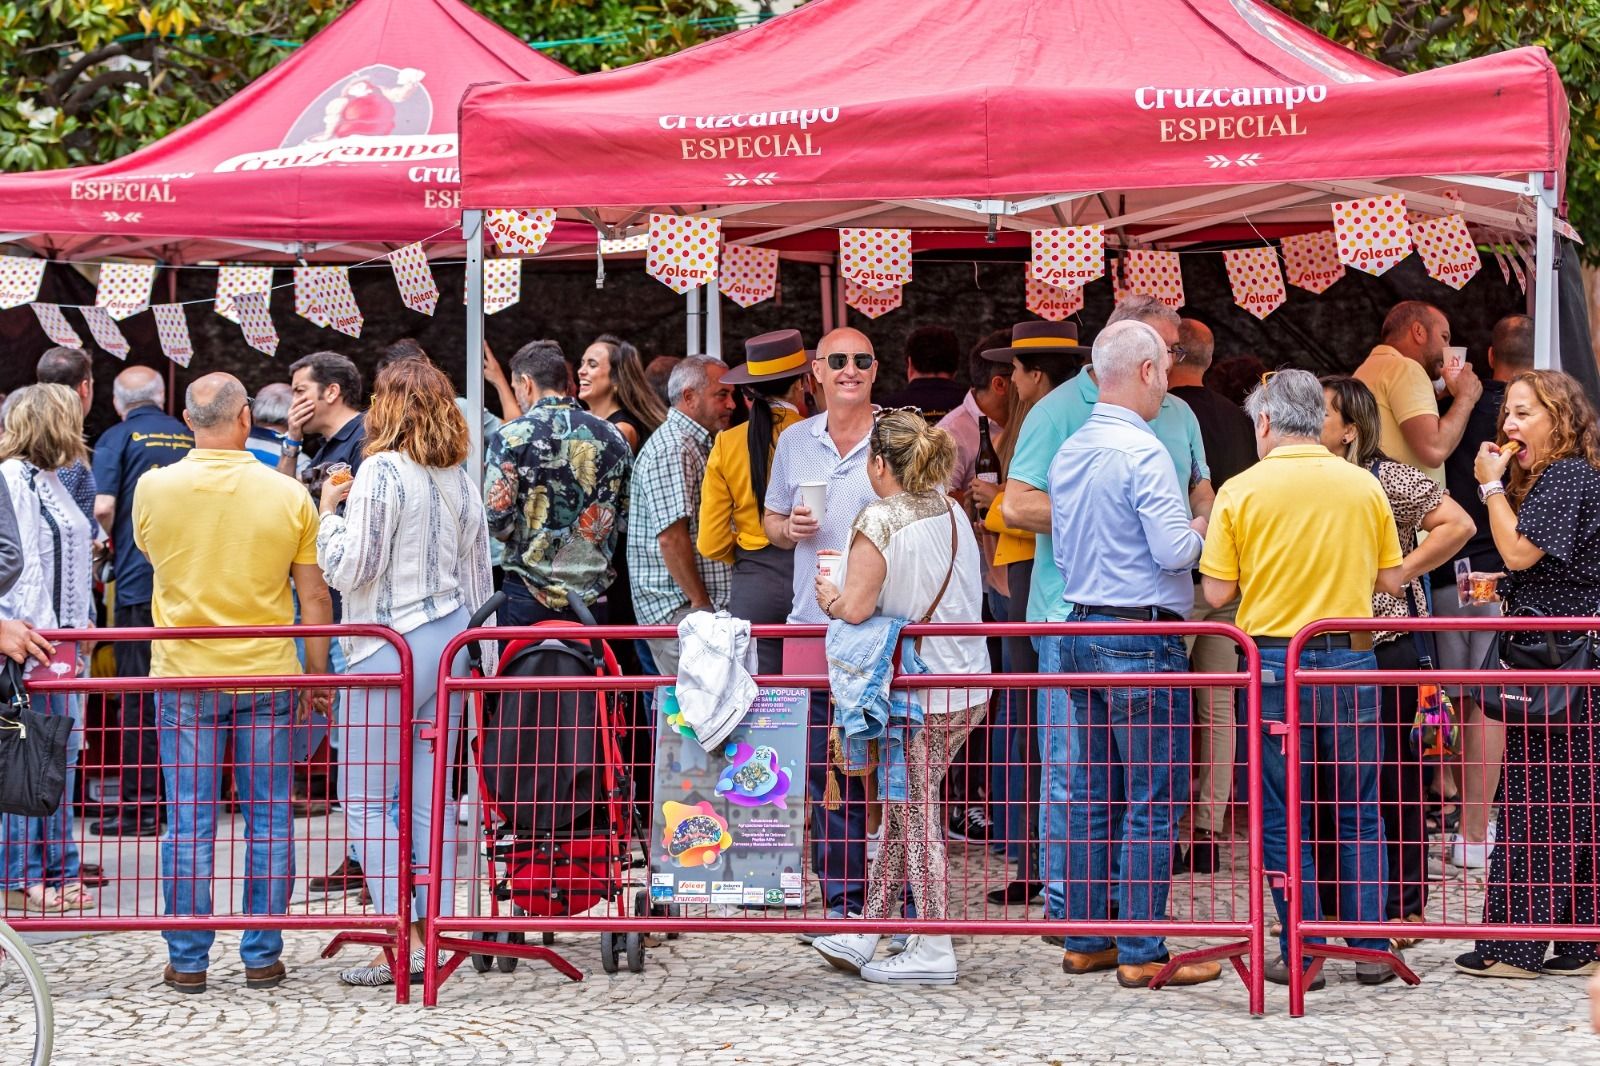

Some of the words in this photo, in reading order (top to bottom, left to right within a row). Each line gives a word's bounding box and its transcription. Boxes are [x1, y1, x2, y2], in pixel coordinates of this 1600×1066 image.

[1134, 84, 1327, 110] Cruzcampo
[1159, 113, 1308, 142] ESPECIAL
[680, 133, 822, 160] ESPECIAL
[70, 181, 177, 203] ESPECIAL
[490, 218, 534, 248] Solear
[1349, 246, 1402, 262] Solear
[656, 263, 708, 279] Solear
[851, 269, 903, 281] Solear
[1042, 268, 1095, 279] Solear
[1437, 261, 1475, 276] Solear
[1296, 270, 1338, 283] Solear
[727, 282, 768, 296] Solear
[105, 300, 143, 310] Solear
[410, 290, 435, 305] Solear
[853, 295, 895, 306] Solear
[1035, 299, 1078, 310] Solear
[1242, 292, 1280, 305] Solear
